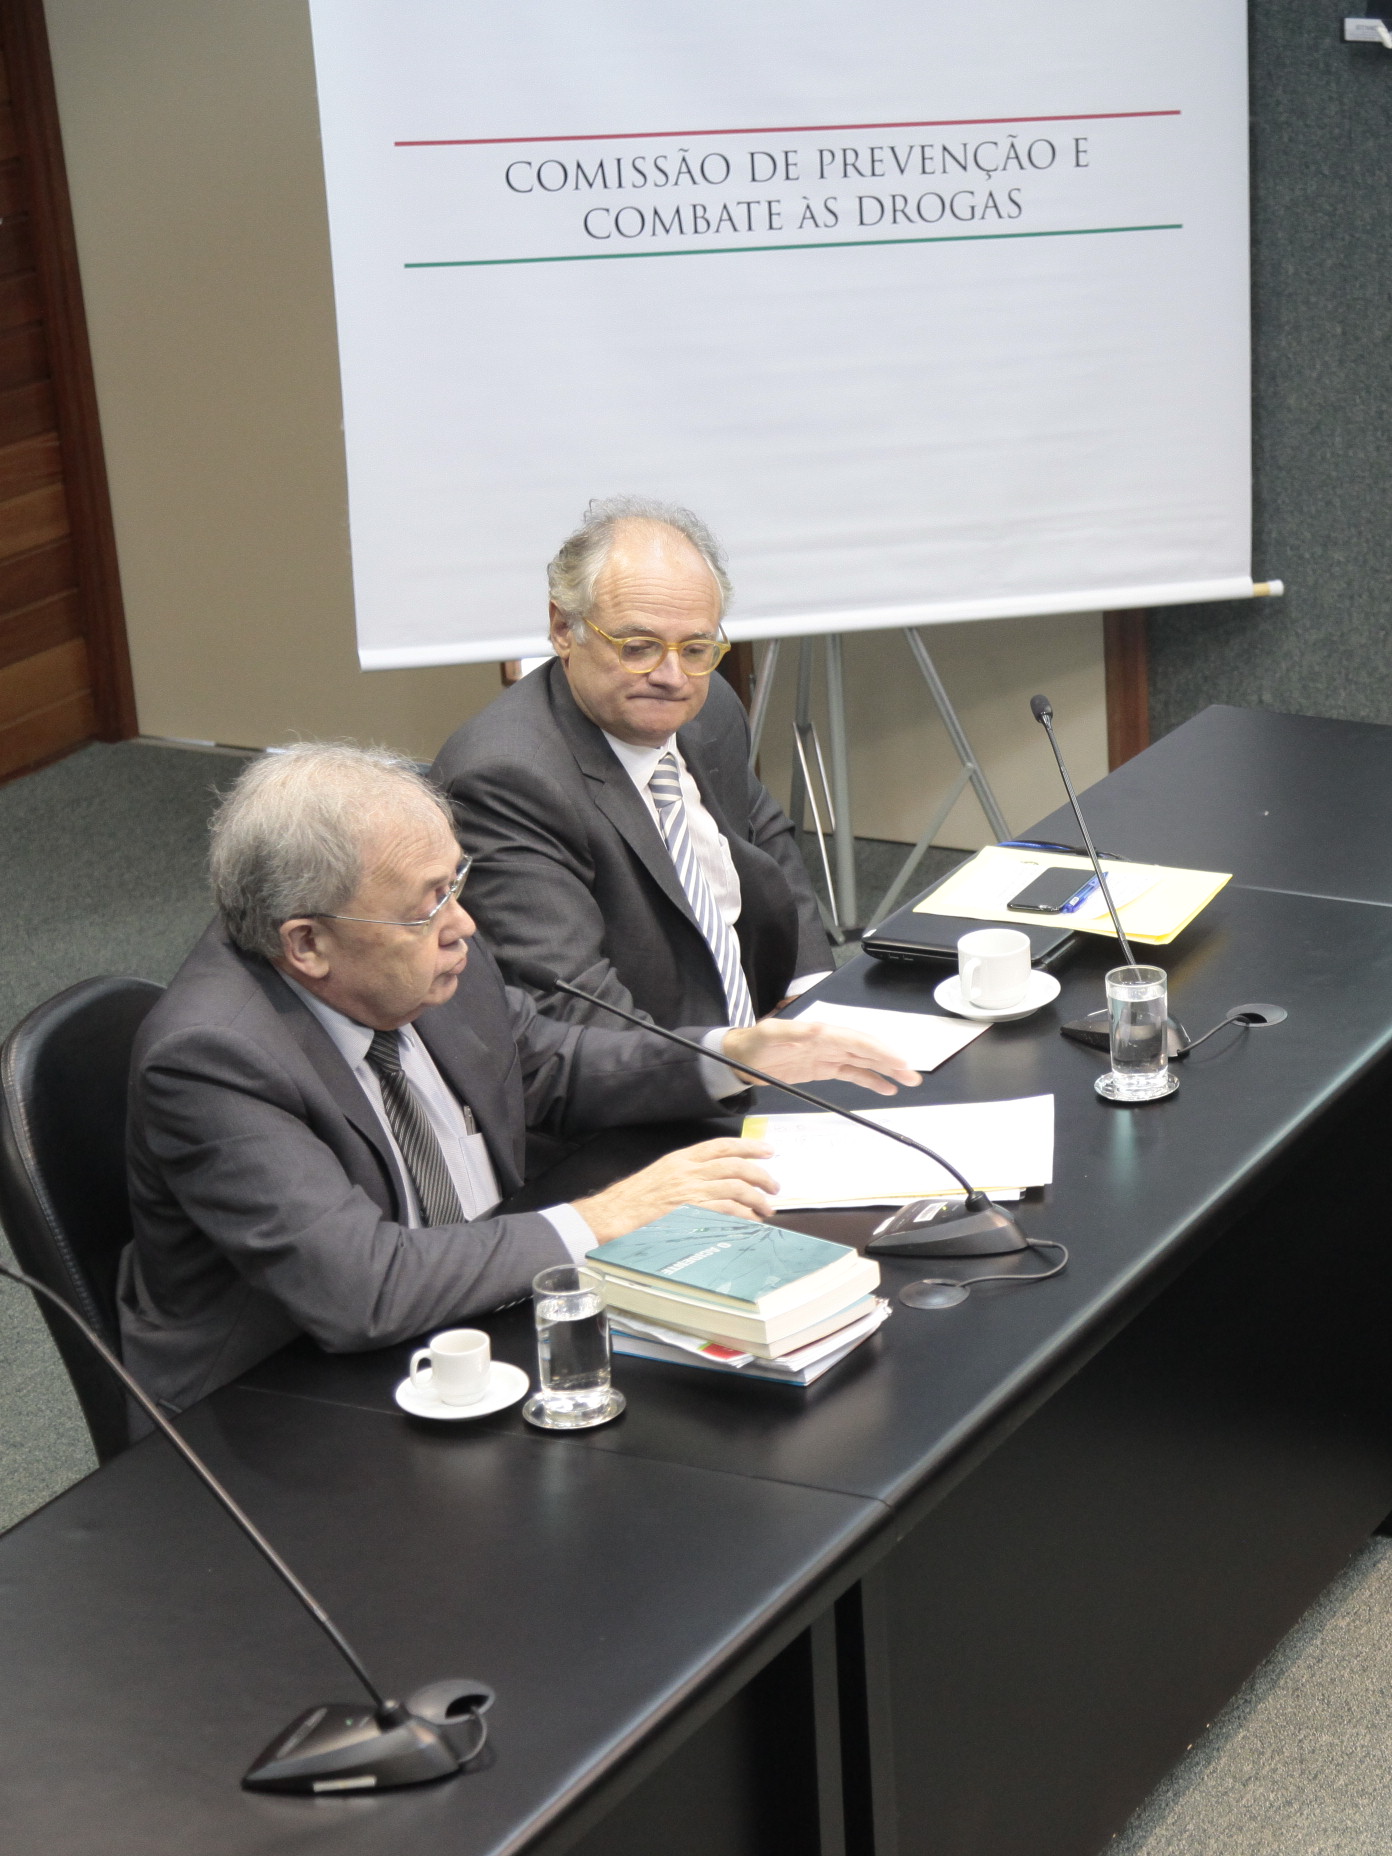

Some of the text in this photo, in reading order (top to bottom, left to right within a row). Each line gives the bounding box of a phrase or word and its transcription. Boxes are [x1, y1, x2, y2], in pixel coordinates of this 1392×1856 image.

[504, 133, 1090, 194] COMISSÃO DE PREVENÇÃO E
[582, 187, 1023, 240] COMBATE ÀS DROGAS
[660, 1246, 721, 1276] ACIDENTE
